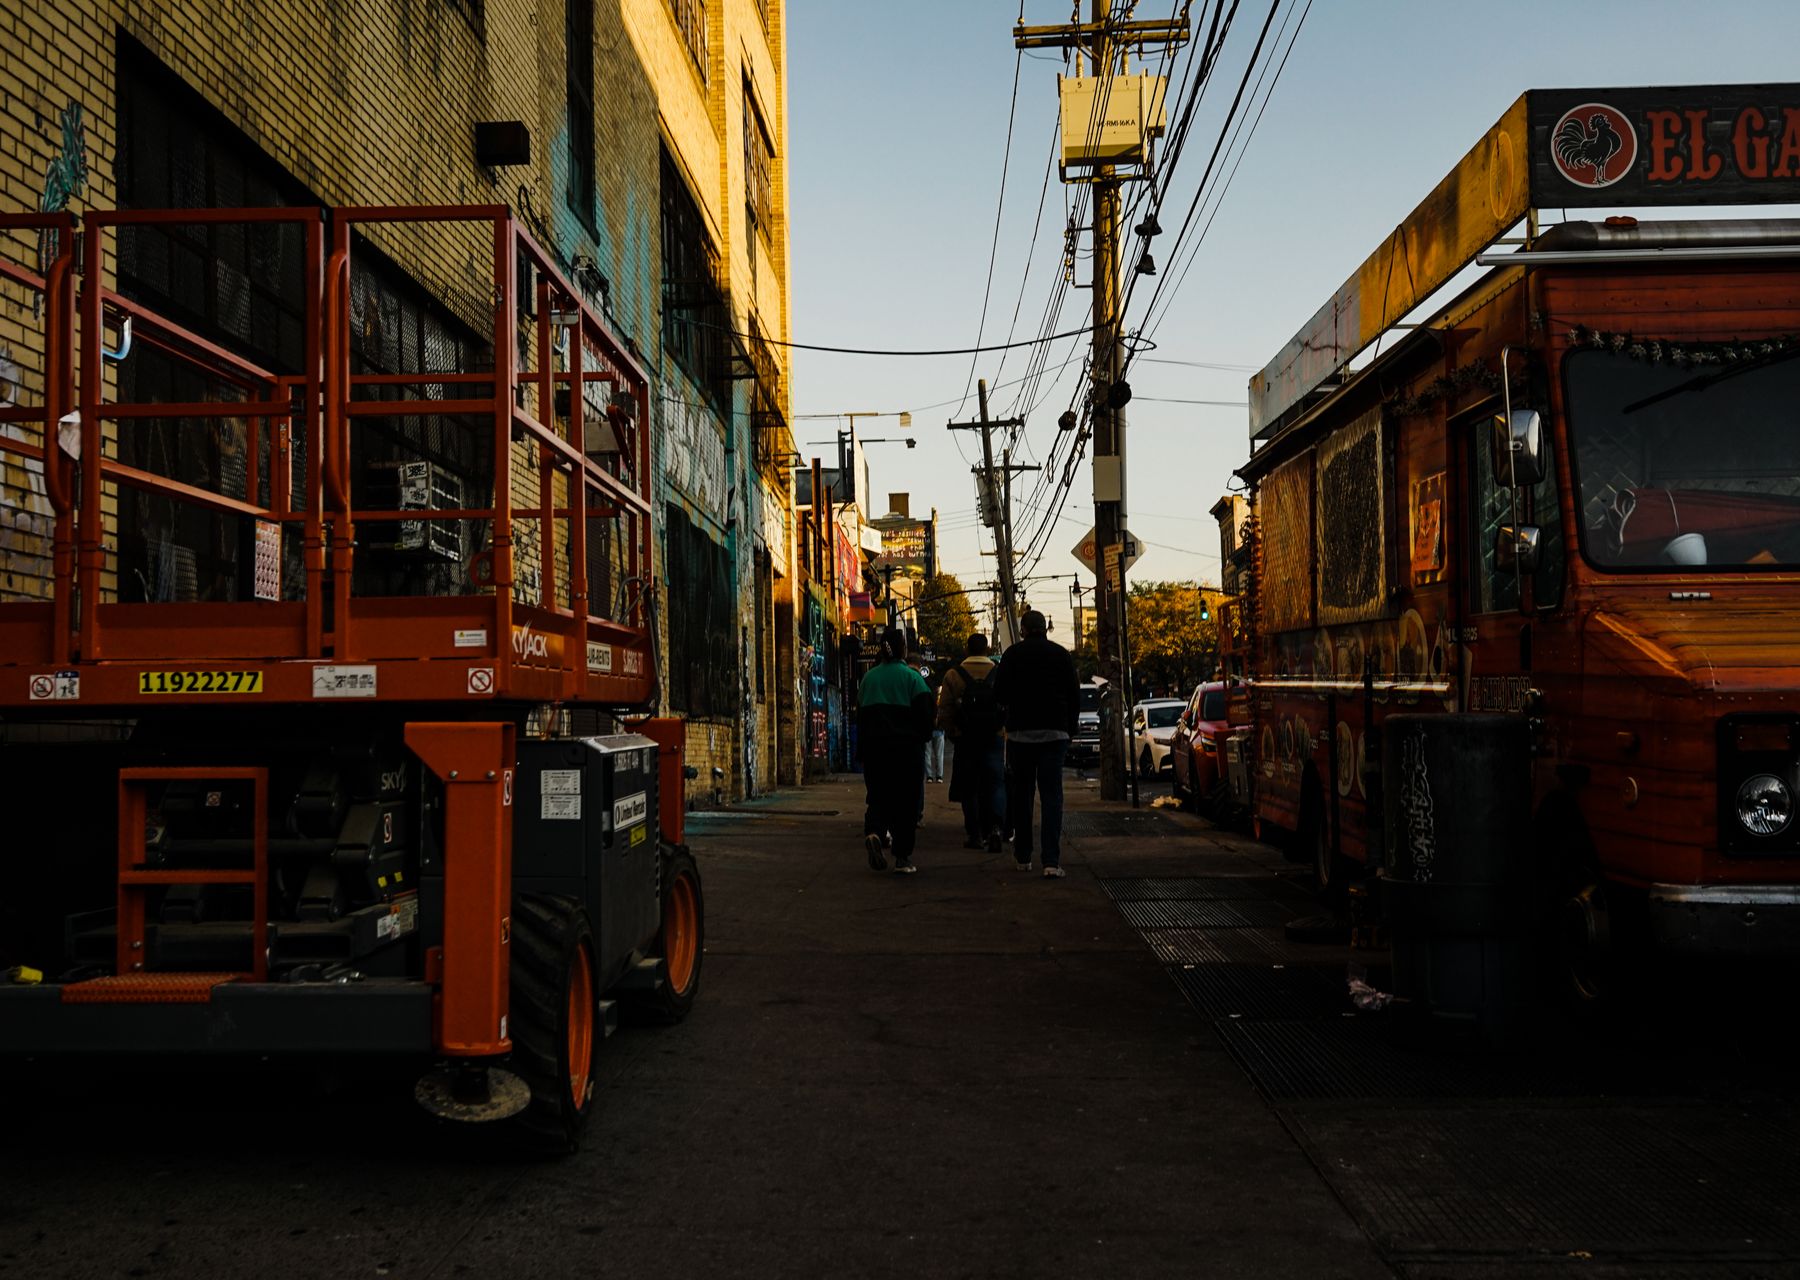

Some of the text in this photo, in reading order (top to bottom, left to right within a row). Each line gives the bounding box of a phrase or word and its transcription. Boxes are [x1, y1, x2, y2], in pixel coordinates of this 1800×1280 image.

[1646, 110, 1723, 181] EL
[512, 619, 548, 660] KYJACK
[141, 671, 259, 692] 11922277
